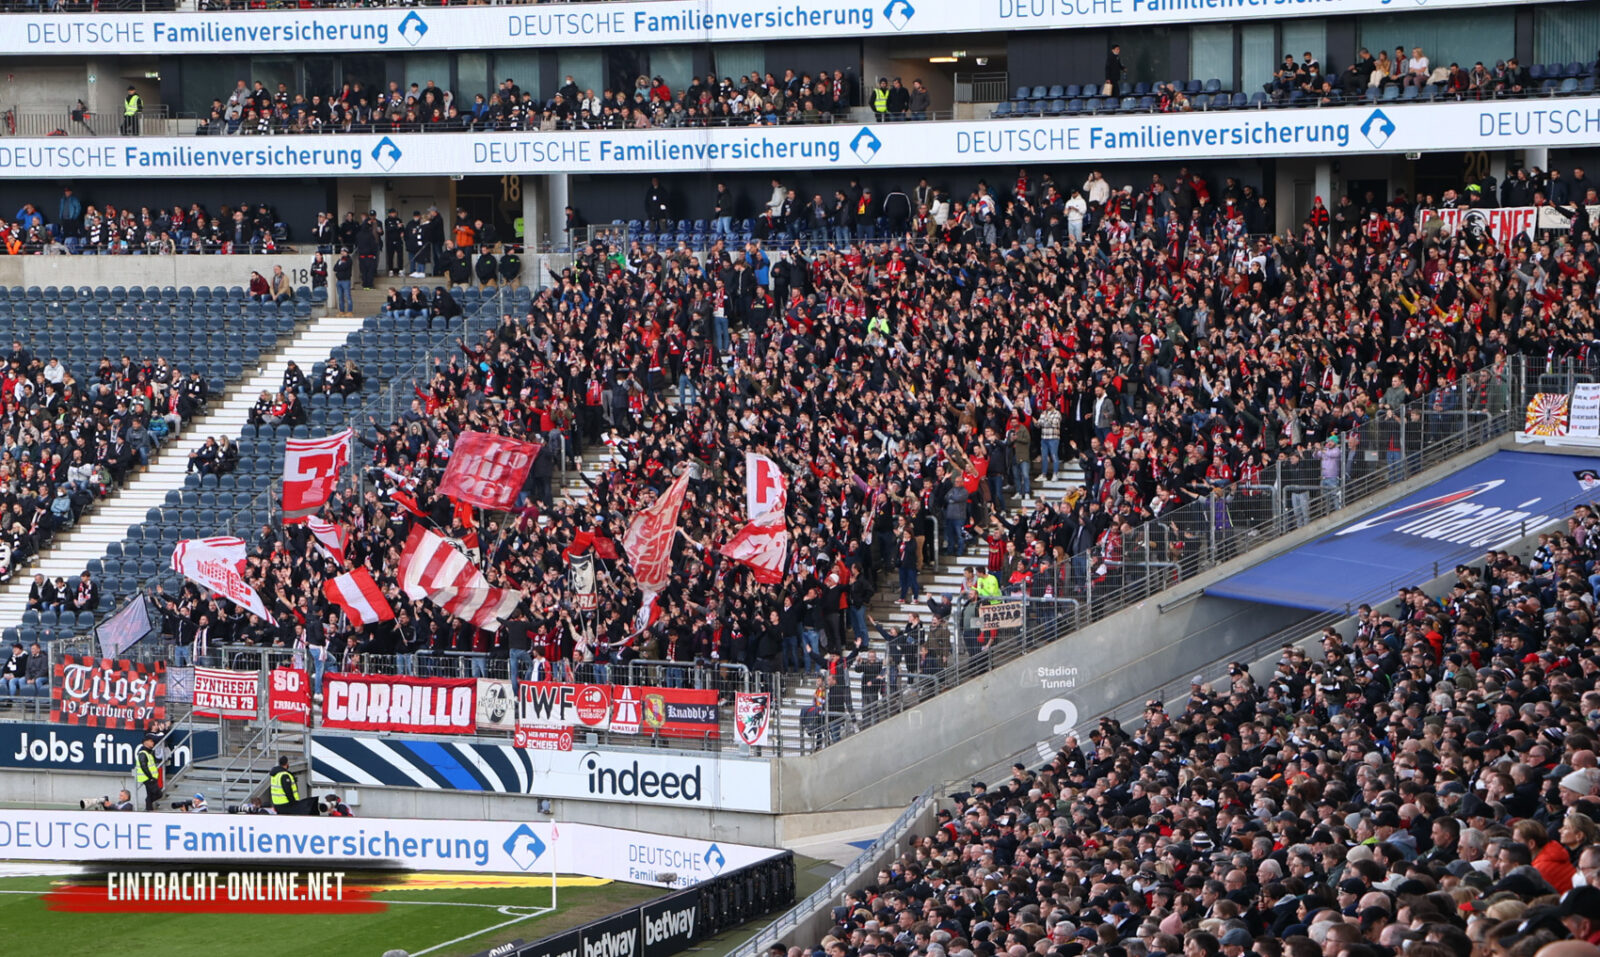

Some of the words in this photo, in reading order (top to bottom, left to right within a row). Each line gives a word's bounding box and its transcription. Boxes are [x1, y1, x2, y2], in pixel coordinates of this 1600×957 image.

[28, 22, 145, 44] DEUTSCHE
[154, 19, 389, 45] Familienversicherung
[508, 12, 625, 37] DEUTSCHE
[634, 5, 874, 34] Familienversicherung
[474, 140, 591, 164] DEUTSCHE
[600, 136, 840, 162] Familienversicherung
[957, 128, 1080, 154] DEUTSCHE
[1090, 120, 1350, 150] Familienversicherung
[0, 147, 117, 168] DEUTSCHE
[125, 144, 362, 170] Familienversicherung
[500, 174, 520, 202] 18
[292, 268, 308, 284] 18
[64, 664, 157, 703] Tifosi
[1038, 666, 1078, 676] Stadion
[1041, 678, 1076, 688] Tunnel
[195, 677, 255, 694] SYNTHESIA
[62, 700, 76, 714] 19
[77, 702, 135, 721] Freiburg
[137, 706, 153, 719] 97
[196, 693, 238, 709] ULTRAS
[240, 697, 254, 709] 79
[327, 681, 473, 726] CORRILLO
[521, 684, 574, 720] IWF
[667, 705, 716, 722] Knaddly's
[1036, 698, 1080, 760] 3
[15, 732, 84, 763] Jobs
[93, 733, 190, 767] finn
[527, 740, 558, 749] SCHEISS
[587, 758, 701, 802] indeed
[0, 820, 152, 850] DEUTSCHE
[165, 825, 490, 866] Familienversicherung
[629, 844, 702, 871] DEUTSCHE
[645, 906, 696, 946] betway
[584, 928, 637, 957] betway
